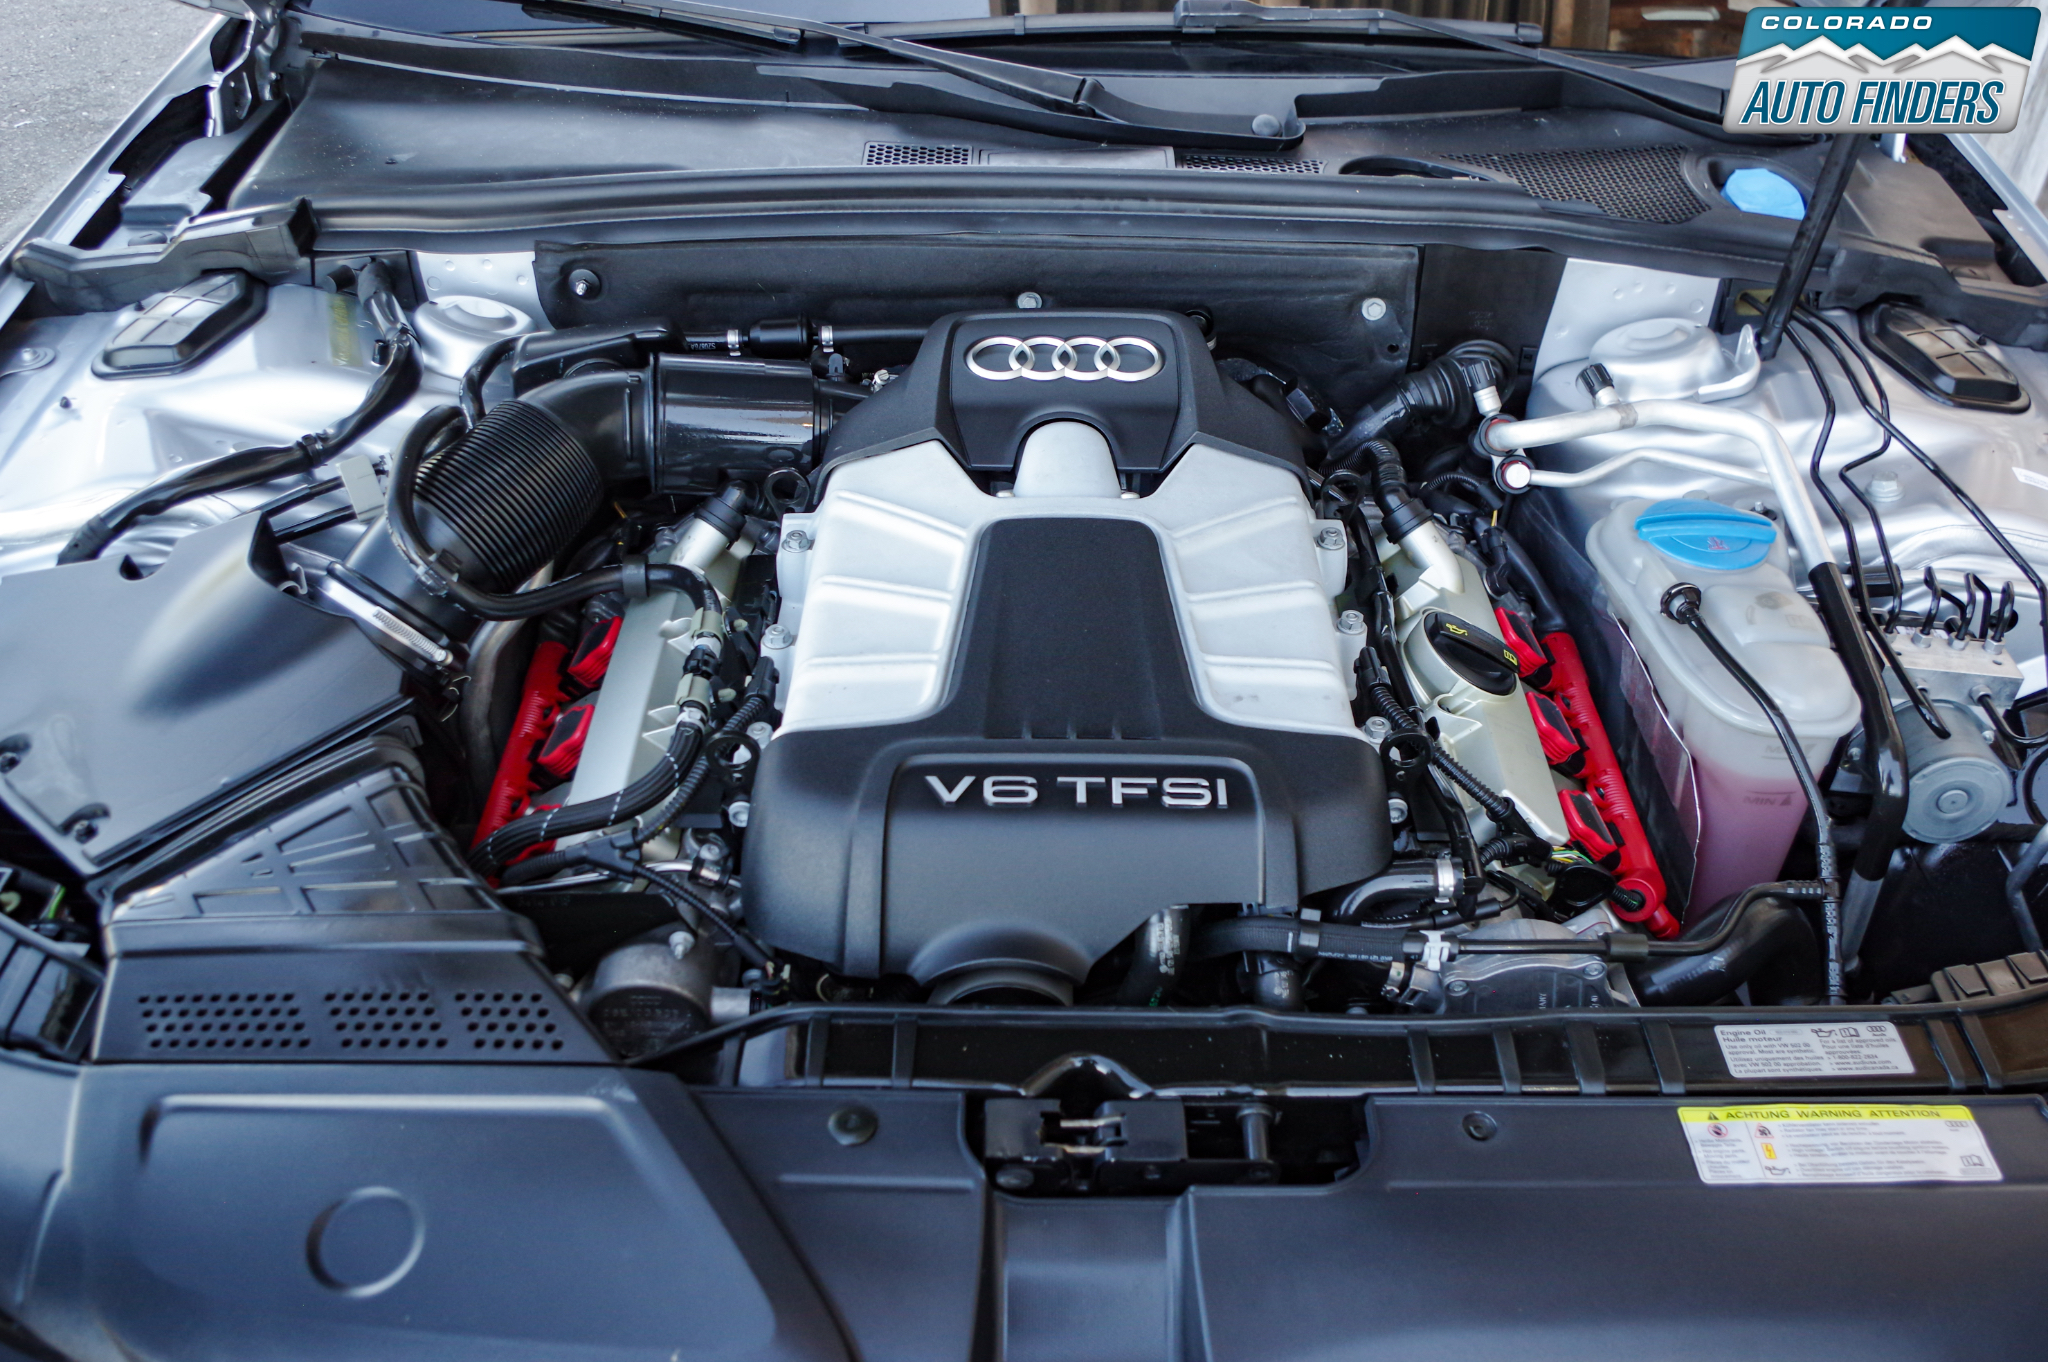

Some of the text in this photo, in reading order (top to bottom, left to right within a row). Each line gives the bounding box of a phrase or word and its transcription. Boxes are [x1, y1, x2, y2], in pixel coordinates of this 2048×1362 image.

[925, 776, 1228, 808] V6 TFSI
[1726, 1110, 1941, 1119] ACHTUNG WARNING ATTENTION
